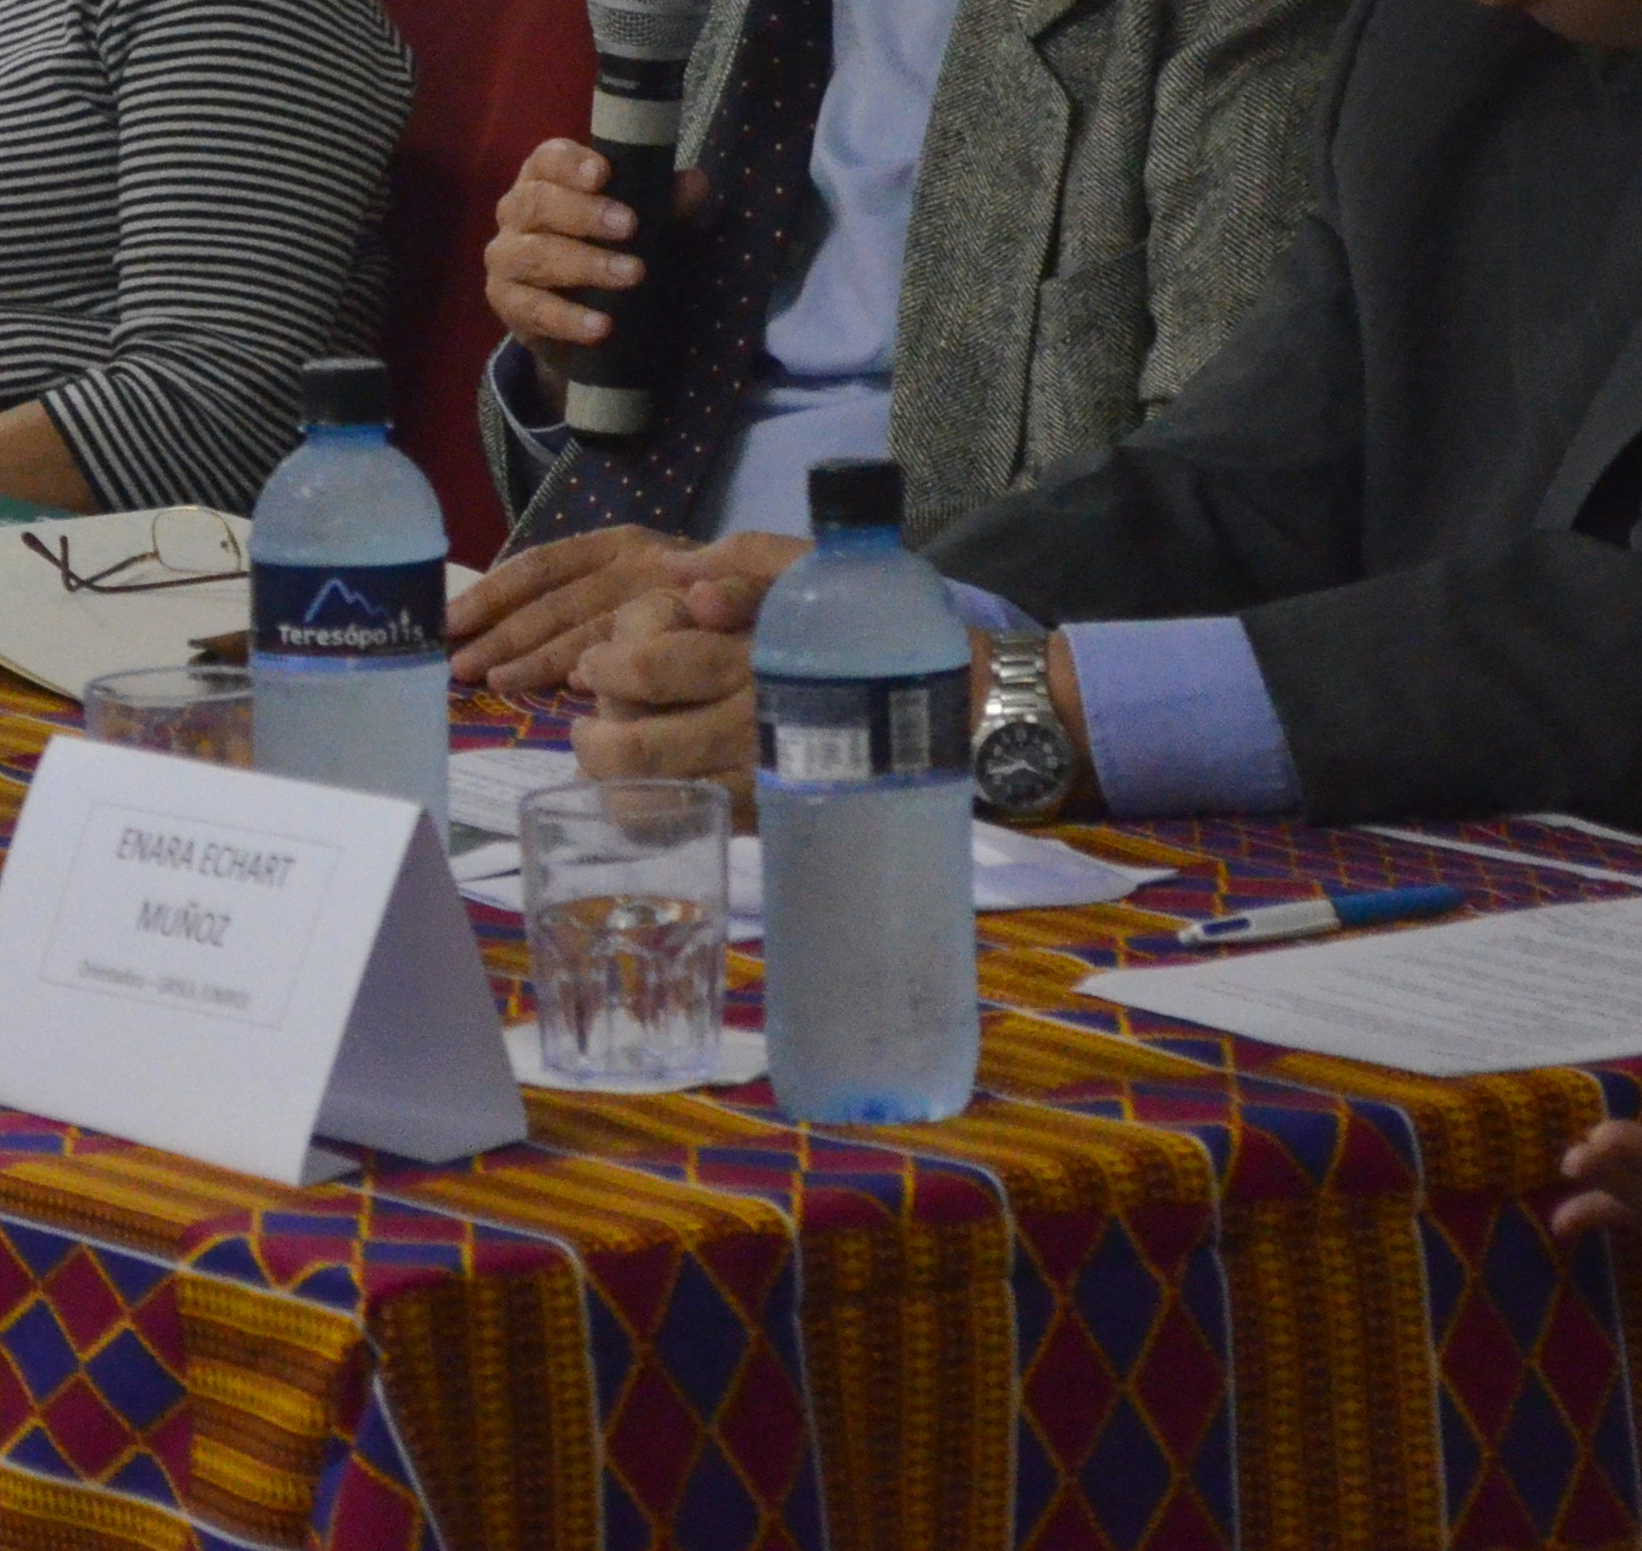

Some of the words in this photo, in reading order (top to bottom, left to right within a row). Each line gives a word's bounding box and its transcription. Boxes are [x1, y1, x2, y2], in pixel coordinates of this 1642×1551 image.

[277, 612, 425, 649] Teresópolis
[116, 827, 196, 873] ENARA
[197, 841, 297, 889] ECHART
[134, 899, 233, 949] MUÑOZ
